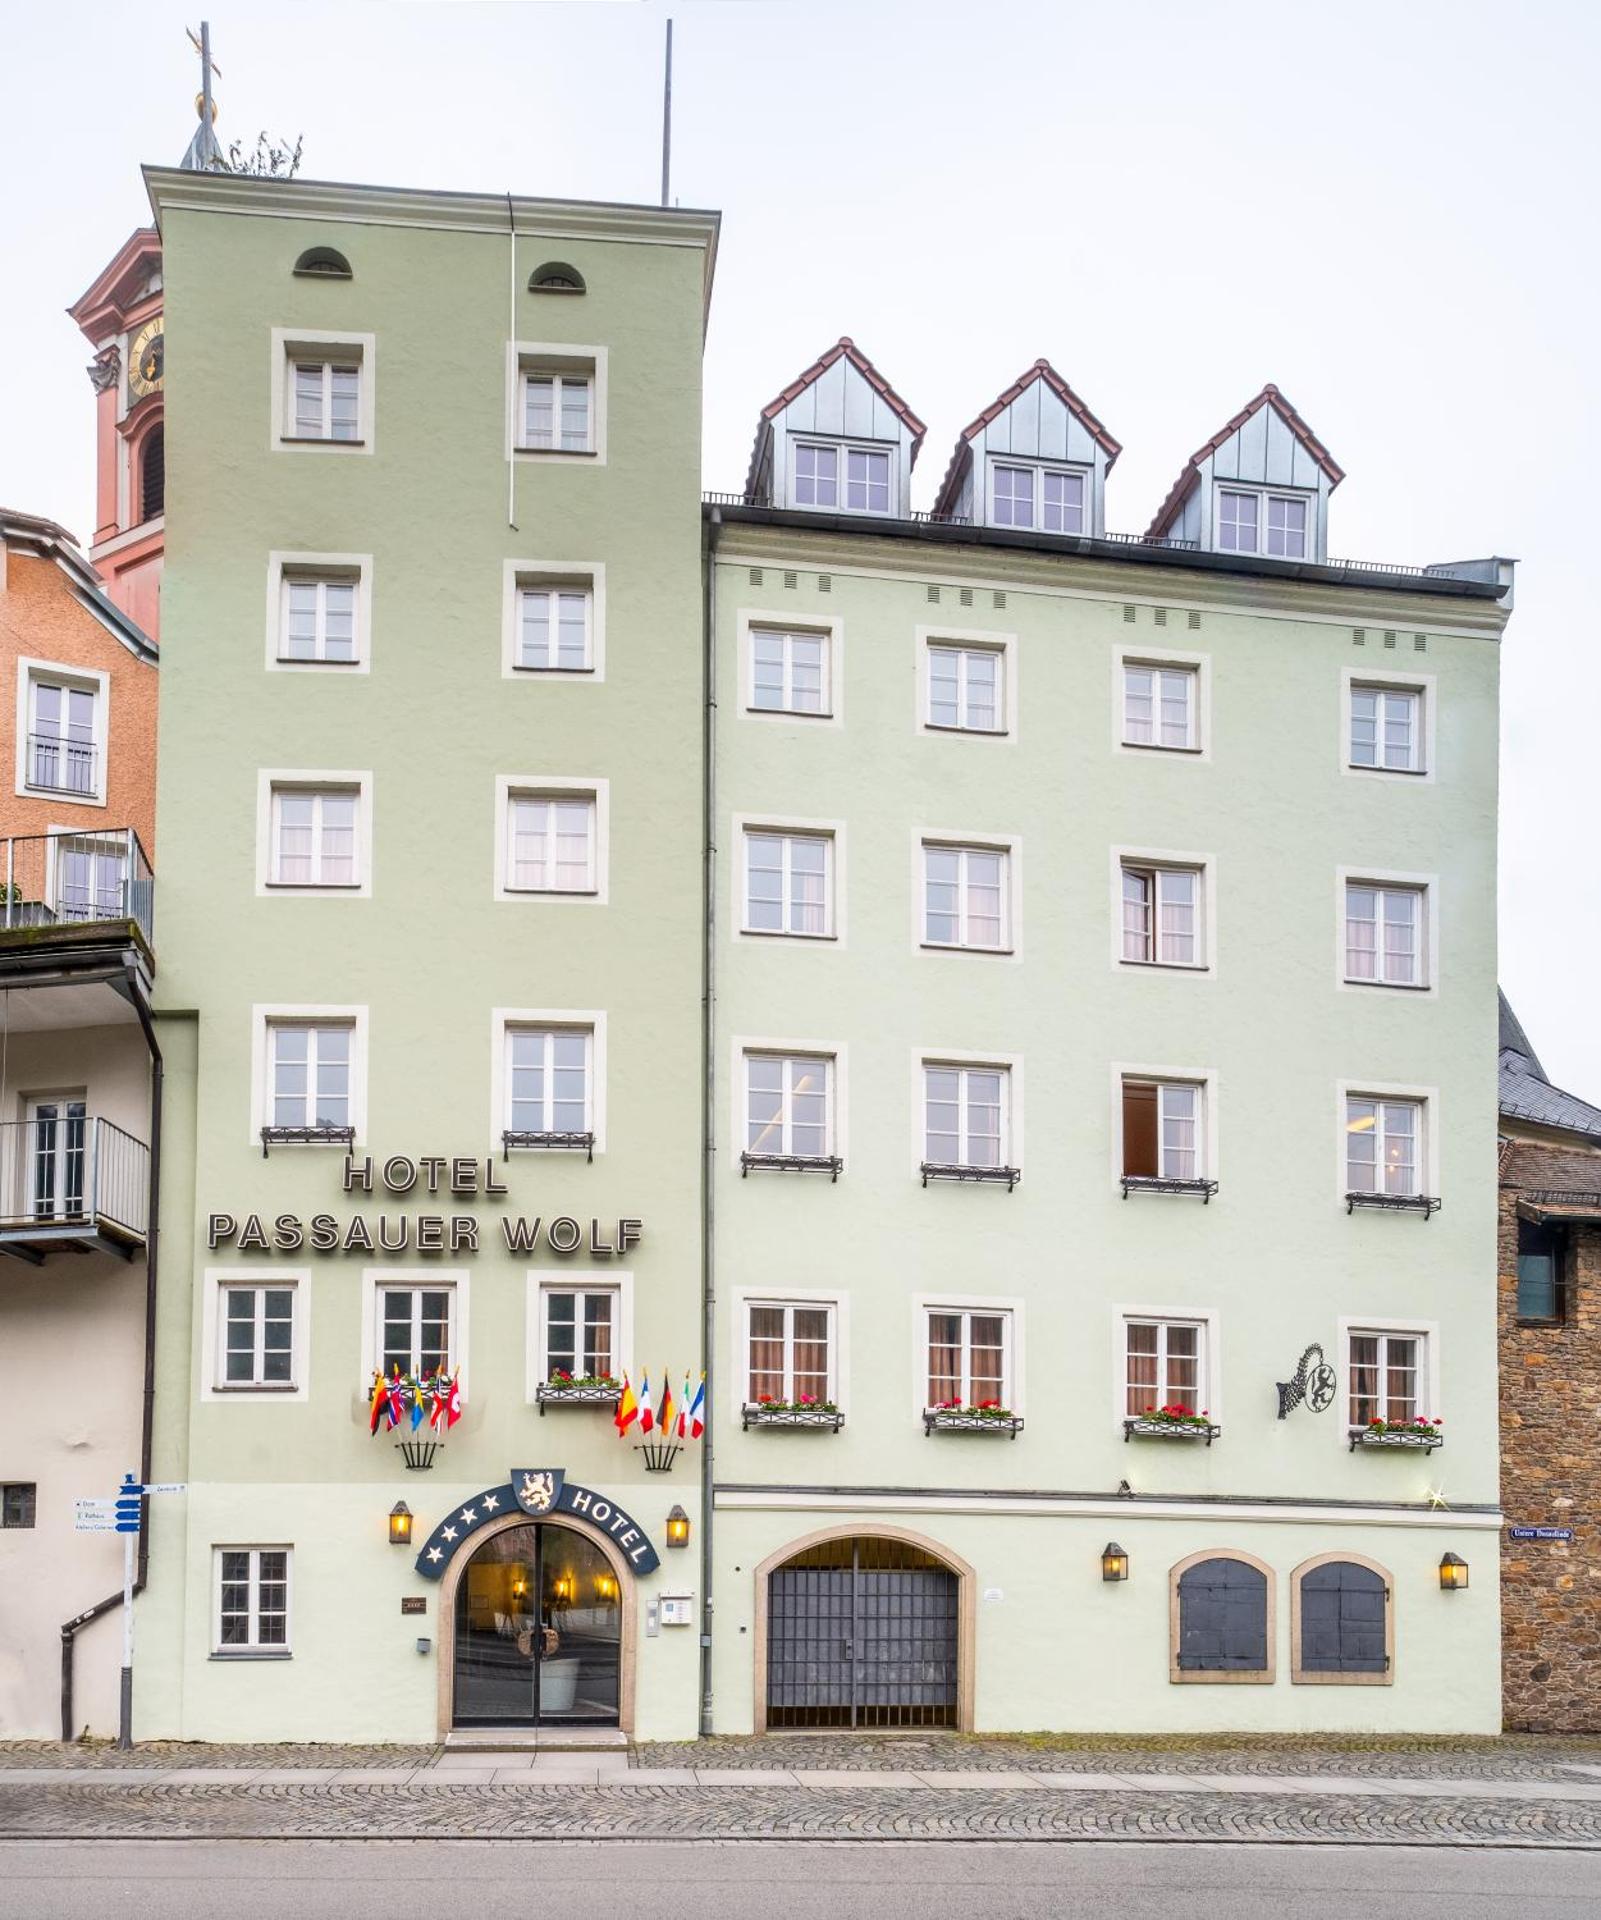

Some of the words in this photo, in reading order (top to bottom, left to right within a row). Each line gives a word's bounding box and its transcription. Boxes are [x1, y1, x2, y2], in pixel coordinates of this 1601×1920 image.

[342, 1155, 509, 1193] HOTEL
[208, 1212, 479, 1252] PASSAUER
[502, 1214, 644, 1254] WOLF
[571, 1490, 648, 1563] HOTEL
